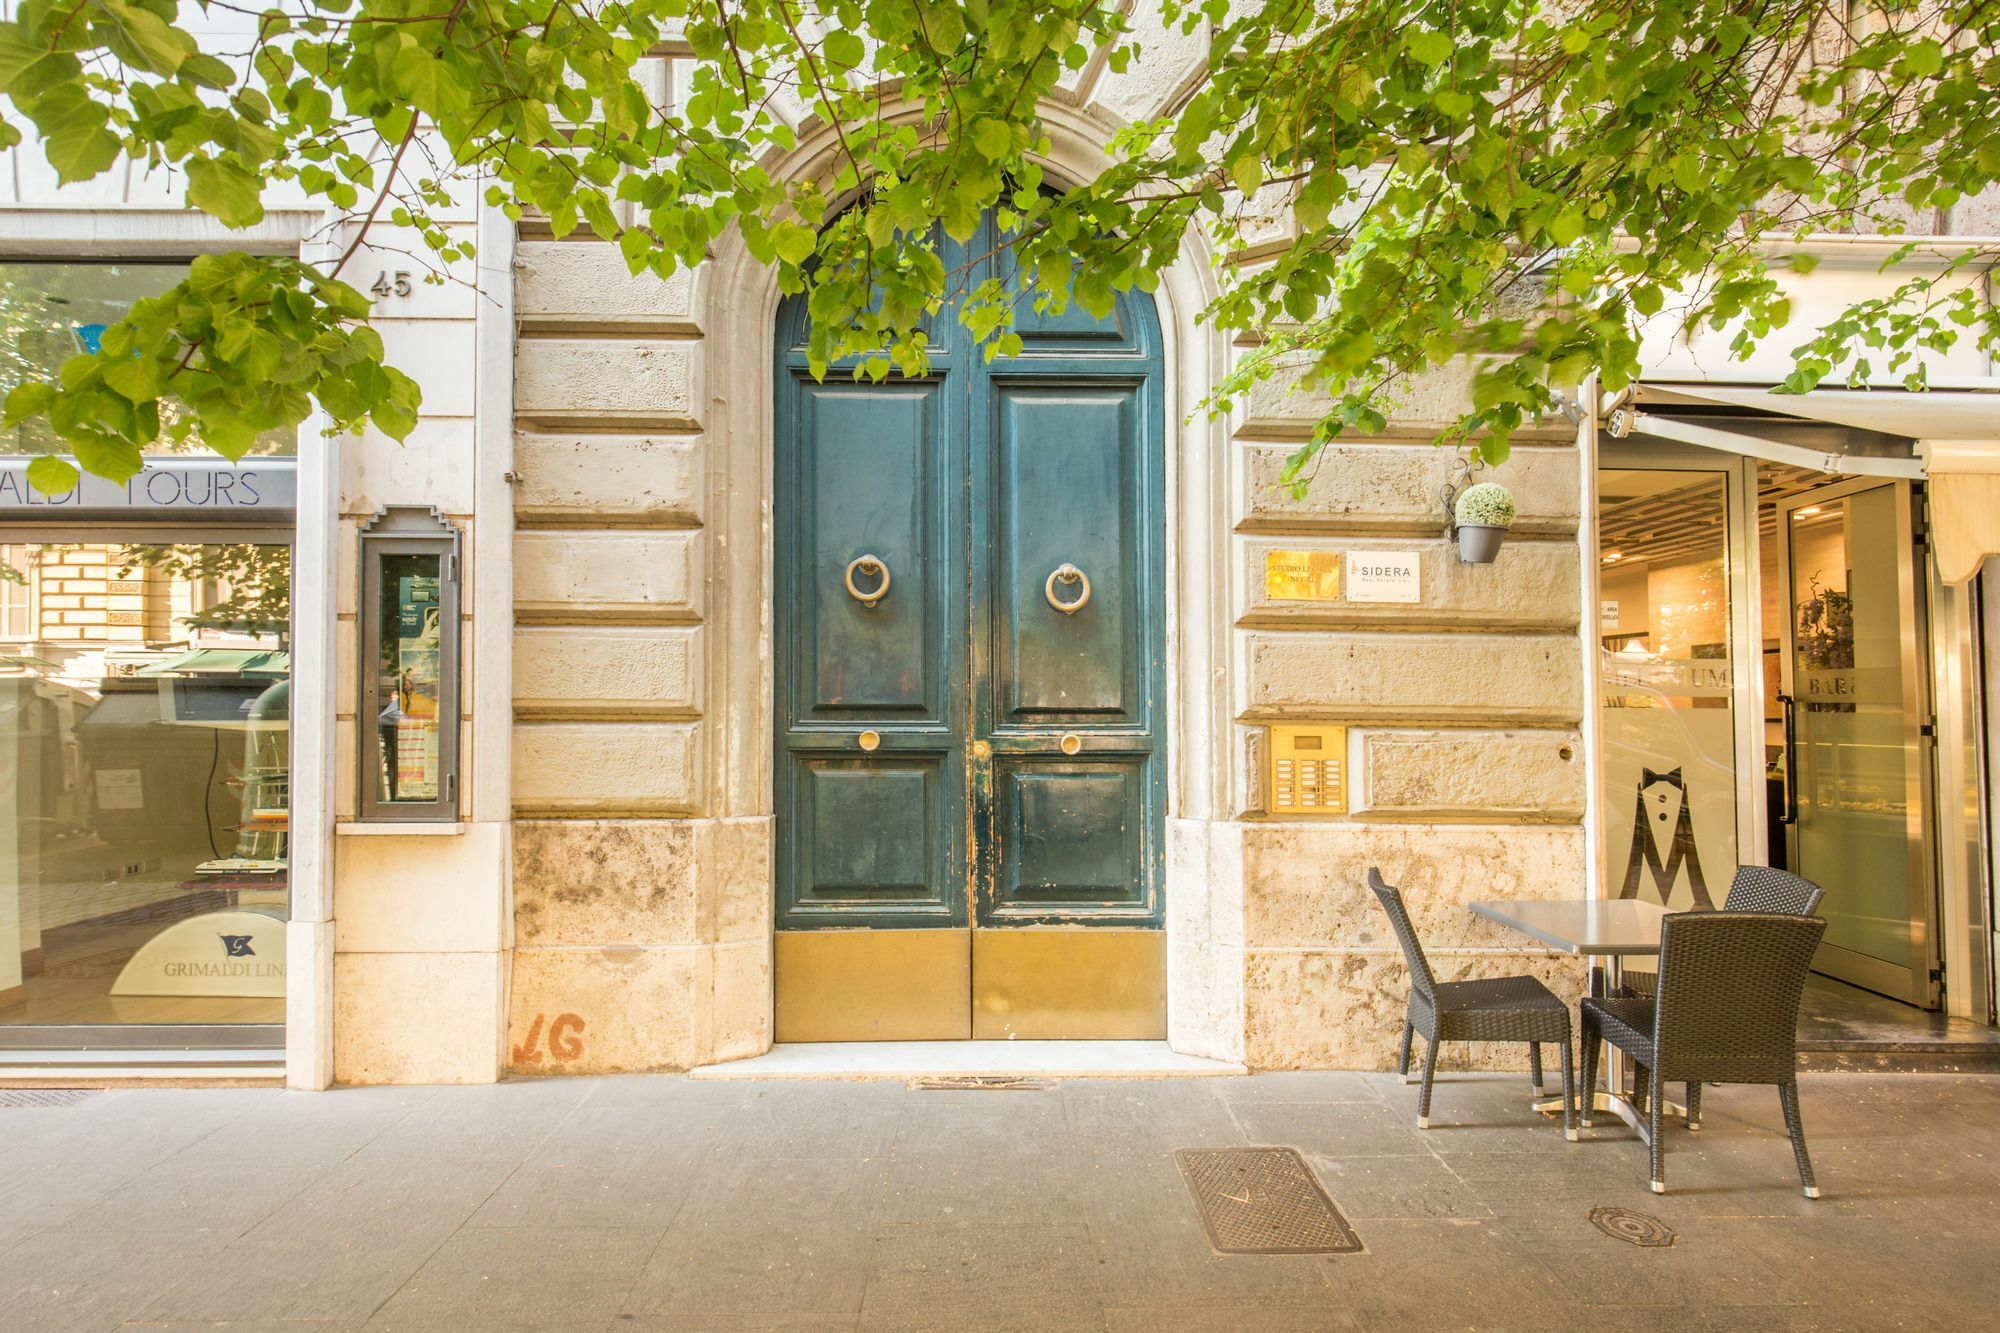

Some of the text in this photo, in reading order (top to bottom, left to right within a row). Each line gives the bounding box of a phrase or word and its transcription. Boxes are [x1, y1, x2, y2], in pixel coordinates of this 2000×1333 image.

[370, 270, 412, 298] 45
[127, 471, 260, 506] TOURS
[1271, 564, 1301, 573] STUDIO
[1361, 566, 1411, 576] SIDERA
[1808, 677, 1847, 695] BAR
[164, 962, 250, 977] GRIMALDI
